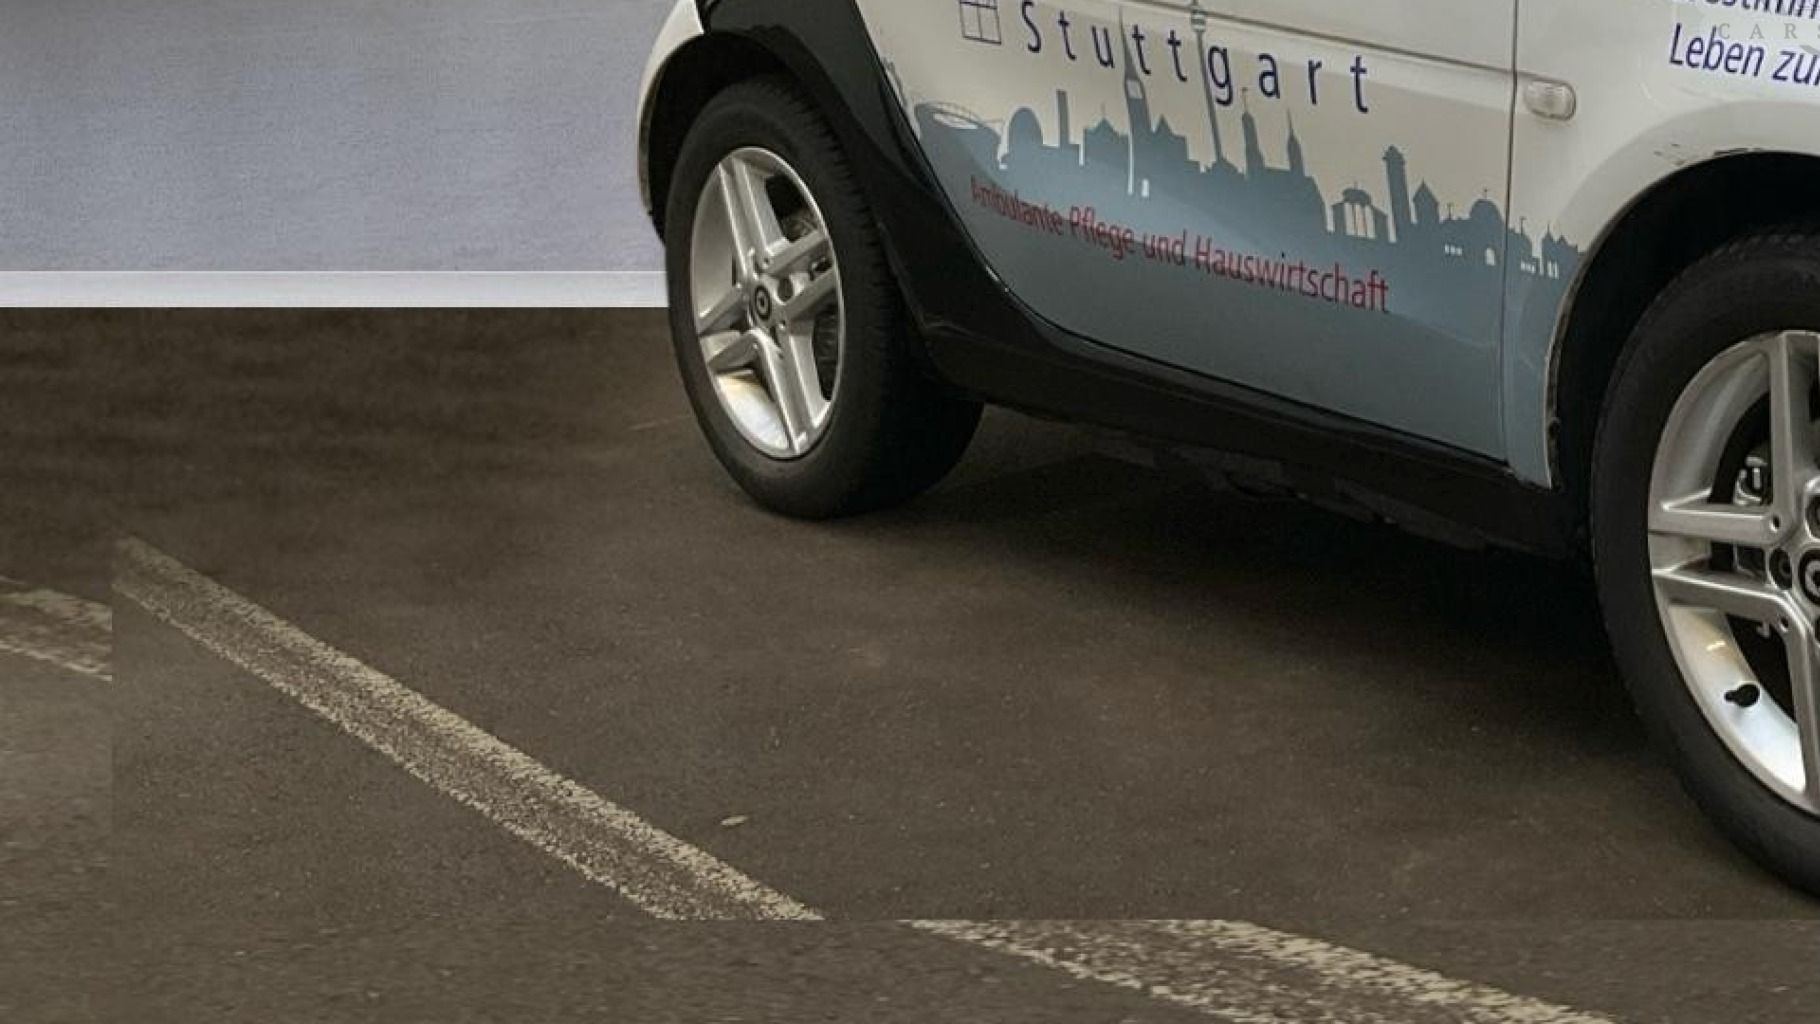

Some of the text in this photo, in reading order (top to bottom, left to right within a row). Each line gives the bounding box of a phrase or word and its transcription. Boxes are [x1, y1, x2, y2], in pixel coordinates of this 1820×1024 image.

[1669, 22, 1765, 77] Leben
[970, 175, 1389, 314] Ambulante Pflege und Hauswirtschaft
